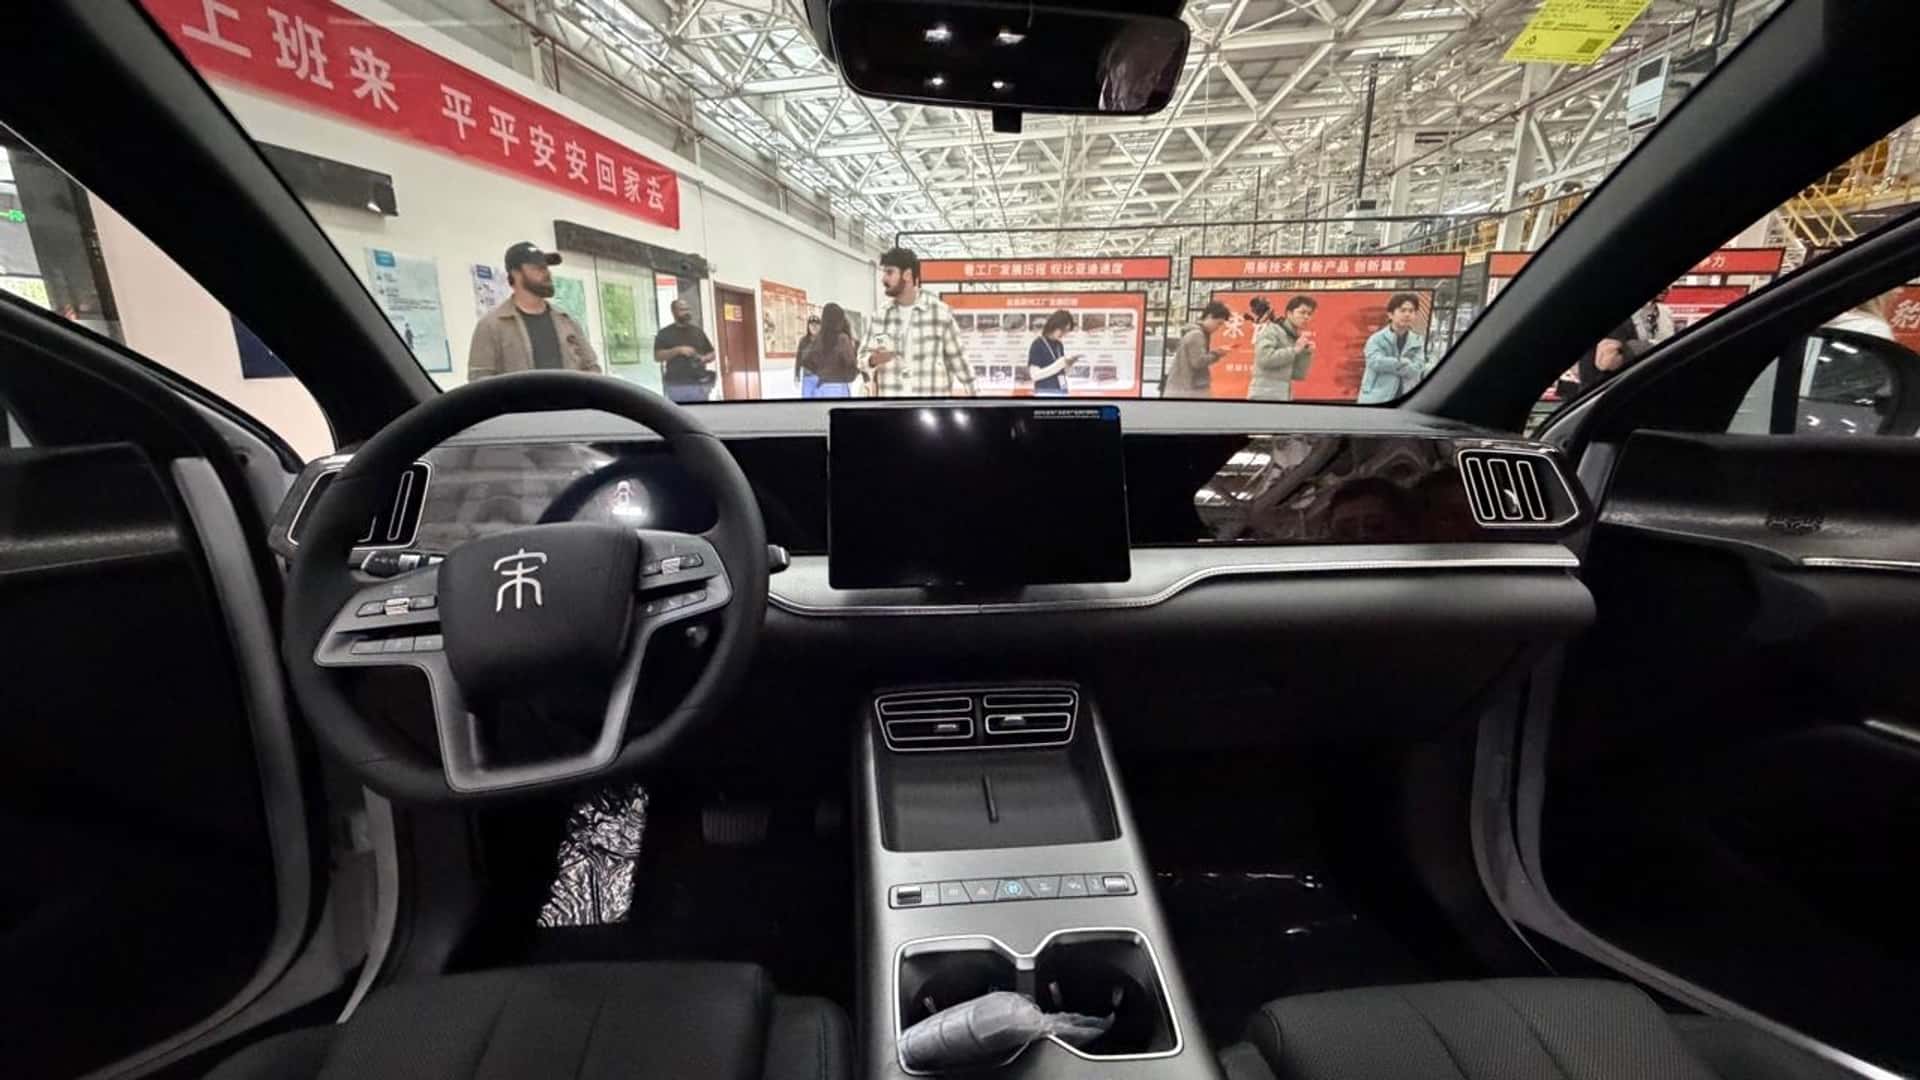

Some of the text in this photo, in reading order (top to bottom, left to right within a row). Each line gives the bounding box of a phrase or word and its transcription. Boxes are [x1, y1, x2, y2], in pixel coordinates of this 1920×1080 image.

[181, 0, 665, 212] 上班来 平平安安回家去
[493, 548, 548, 612] 宋
